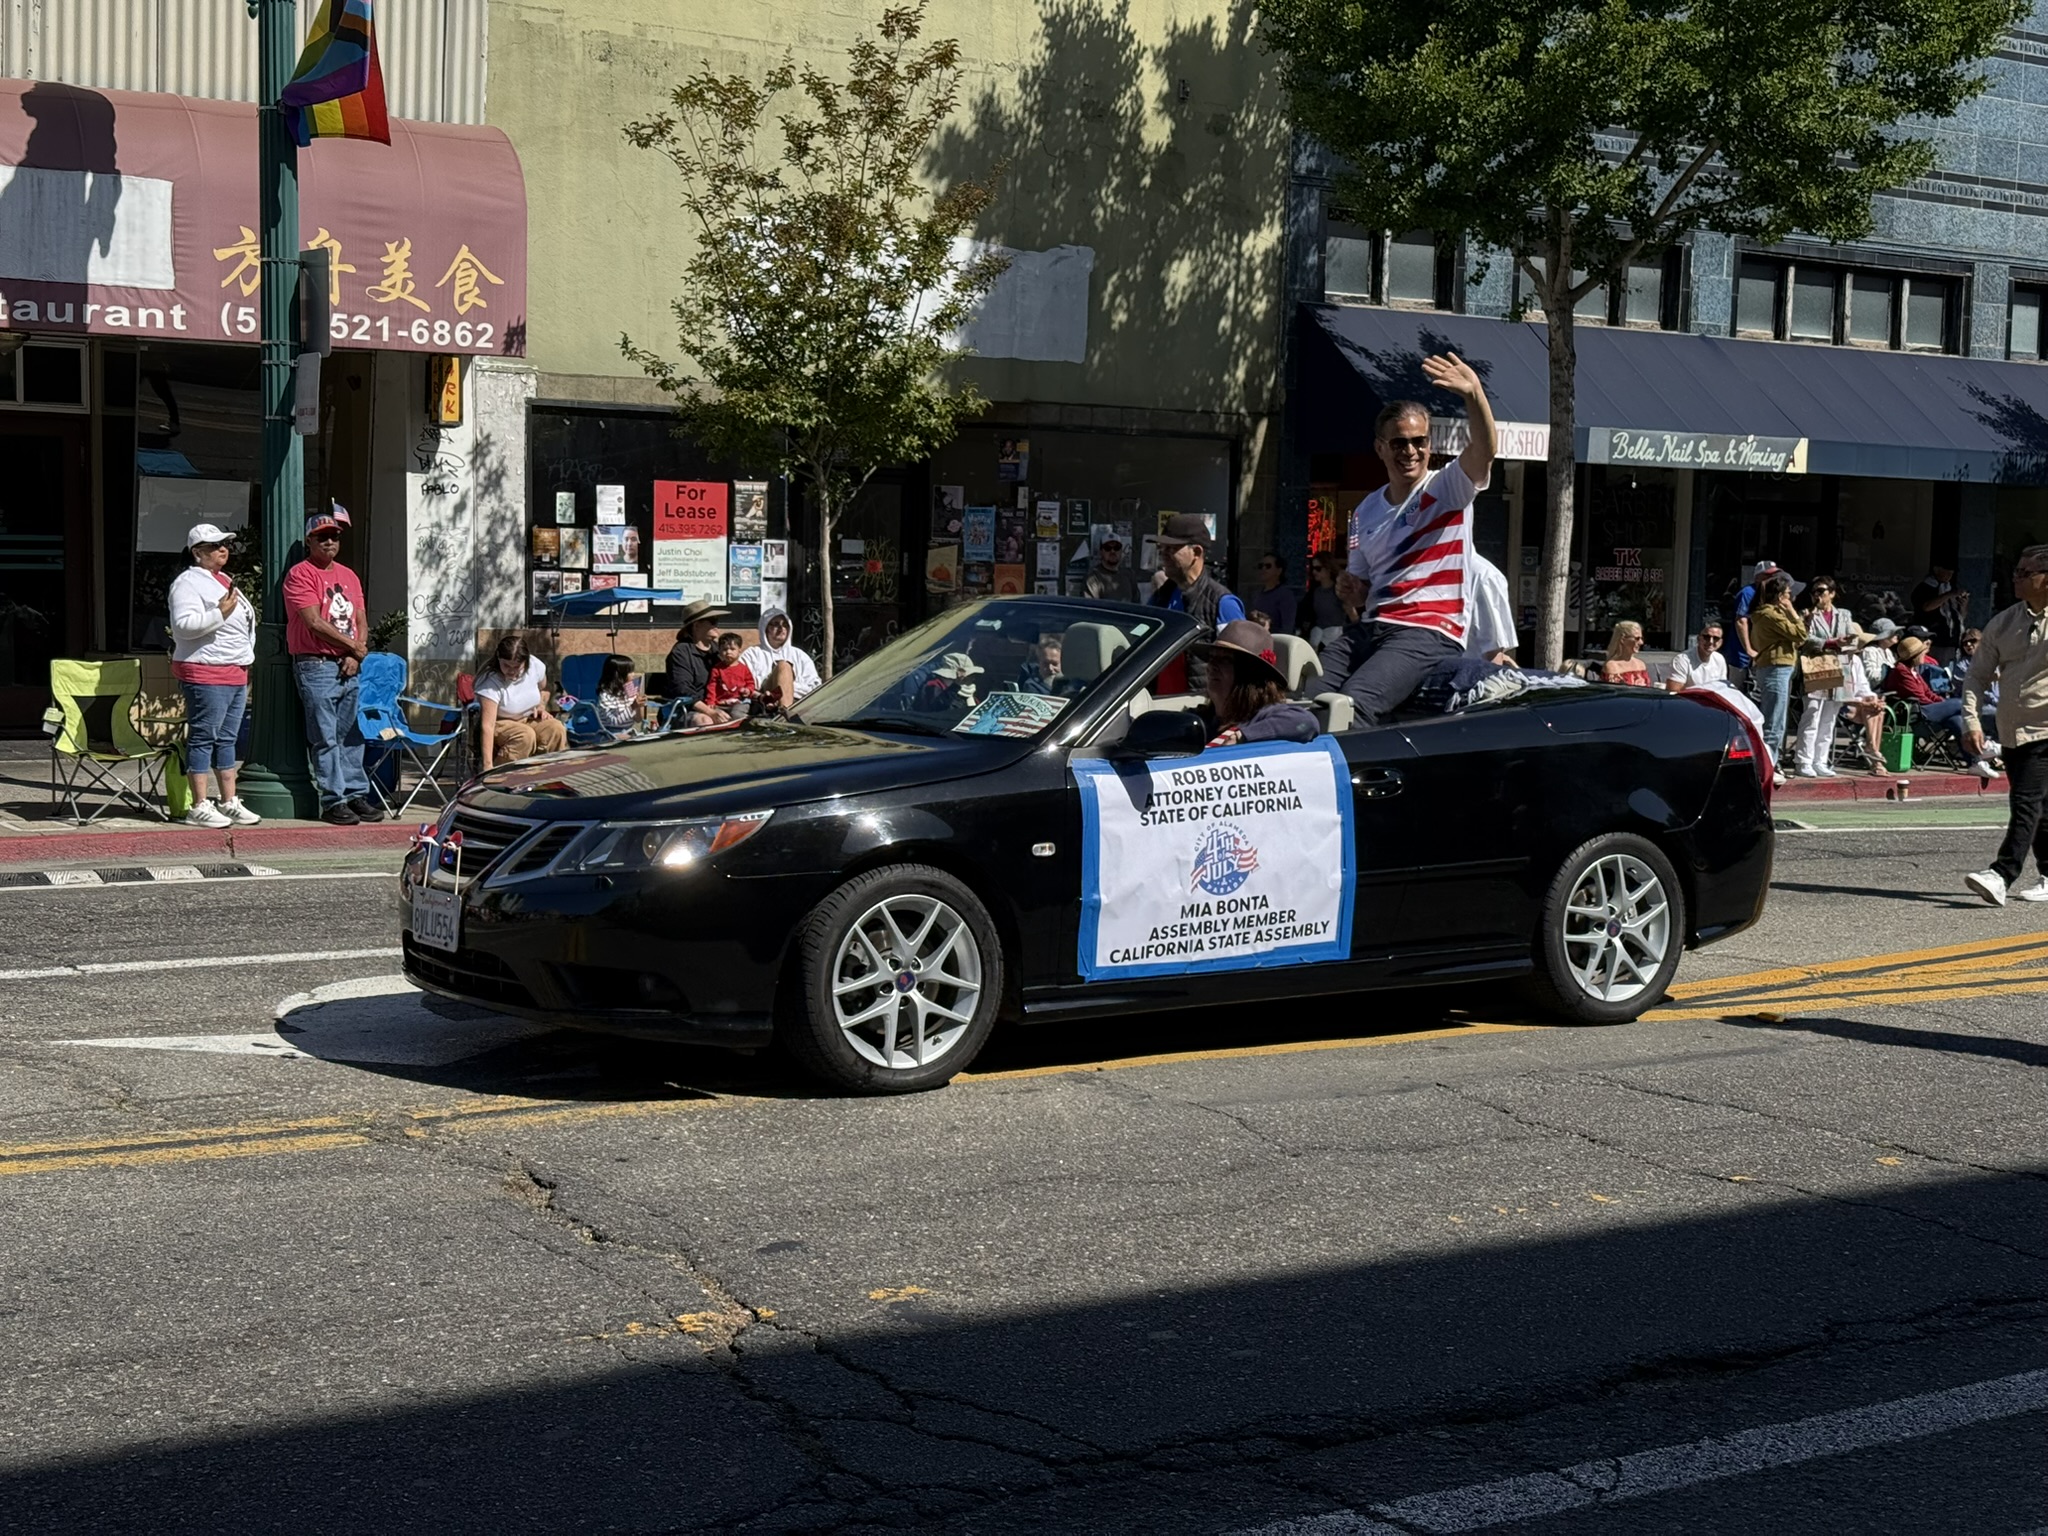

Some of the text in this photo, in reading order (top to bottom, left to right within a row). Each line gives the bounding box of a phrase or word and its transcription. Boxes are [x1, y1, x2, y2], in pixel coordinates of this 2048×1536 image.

[330, 313, 494, 349] 521-6862
[1612, 432, 1787, 472] Bella Nail Spa & Waxing
[421, 482, 460, 496] PABLO
[676, 484, 707, 500] For
[665, 502, 717, 519] Lease
[657, 547, 703, 556] Justin Choi
[1613, 547, 1642, 566] TK
[656, 569, 717, 577] Jeff Badstubner
[1595, 566, 1623, 581] BARBER
[1624, 567, 1643, 582] SHOP
[1650, 568, 1664, 582] SPA
[713, 594, 724, 602] JLL
[1172, 763, 1265, 787] ROB BONTA
[1144, 778, 1297, 808] ATTORNEY GENERAL
[1140, 796, 1303, 827] STATE OF CALIFORNIA
[1194, 832, 1205, 852] CITY
[1207, 822, 1215, 831] OF
[1206, 829, 1236, 863] 4TH
[1201, 853, 1241, 883] JULY
[1206, 876, 1244, 893] PARADE
[1180, 894, 1269, 920] MIA BONTA
[414, 907, 454, 943] 8VLU554
[1148, 909, 1297, 942] ASSEMBLY MEMBER
[1109, 920, 1330, 964] CALIFORNIA STATE ASSEMBLY
